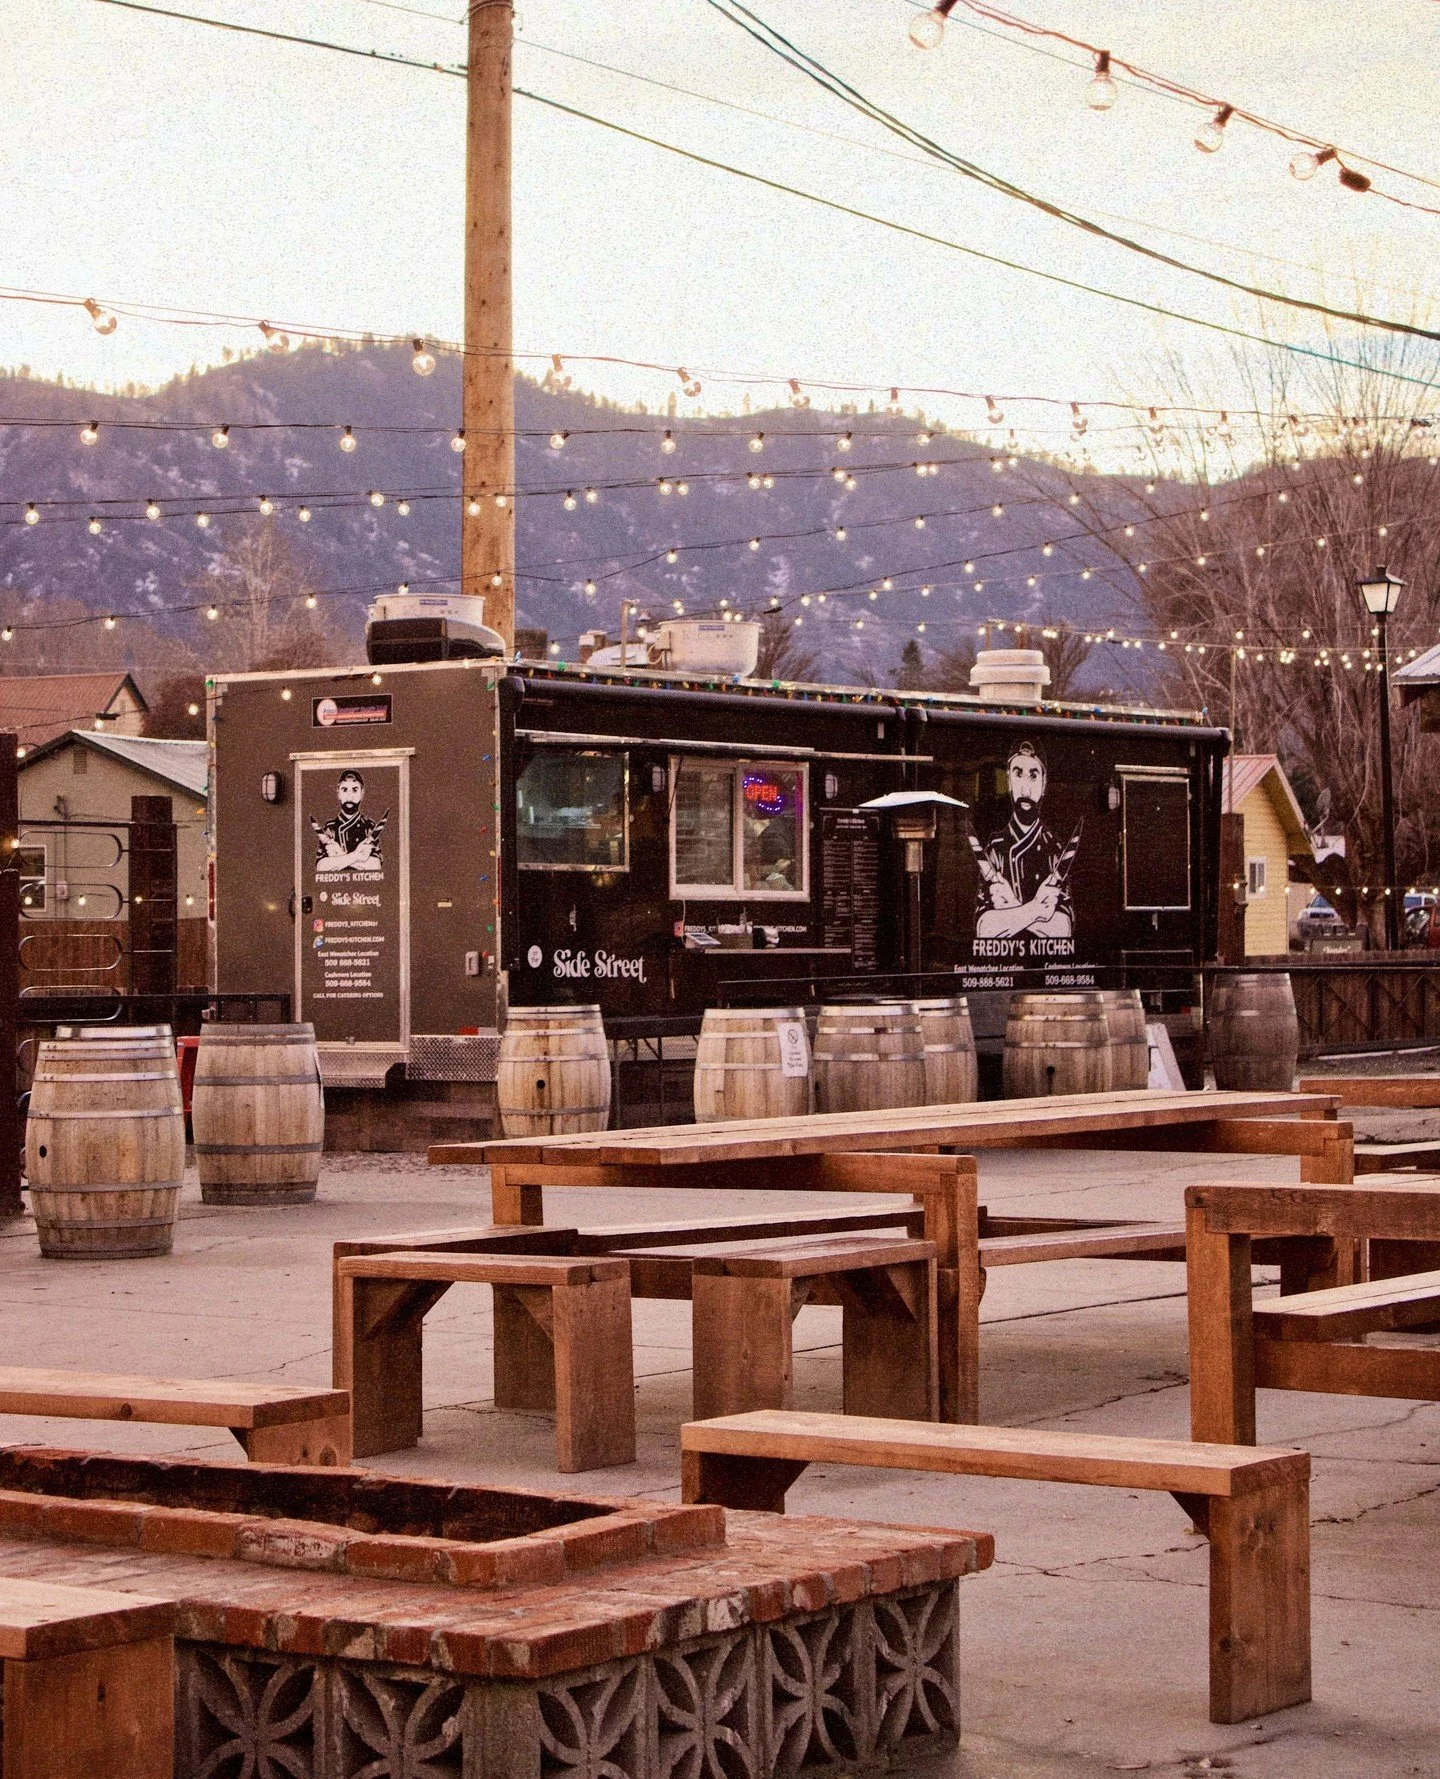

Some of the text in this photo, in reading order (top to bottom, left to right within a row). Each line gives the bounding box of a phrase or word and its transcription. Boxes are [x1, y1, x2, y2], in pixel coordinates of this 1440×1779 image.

[745, 783, 778, 802] OPEN
[315, 872, 384, 882] FREDDY'S KITCHEN
[331, 892, 381, 907] Side Street
[972, 939, 1075, 956] FREDDY'S KITCHEN
[324, 959, 338, 967] 509
[553, 949, 591, 978] Side
[594, 949, 647, 983] Street
[953, 964, 967, 973] East
[1000, 963, 1024, 971] Location
[962, 976, 1014, 988] 509-888-5621
